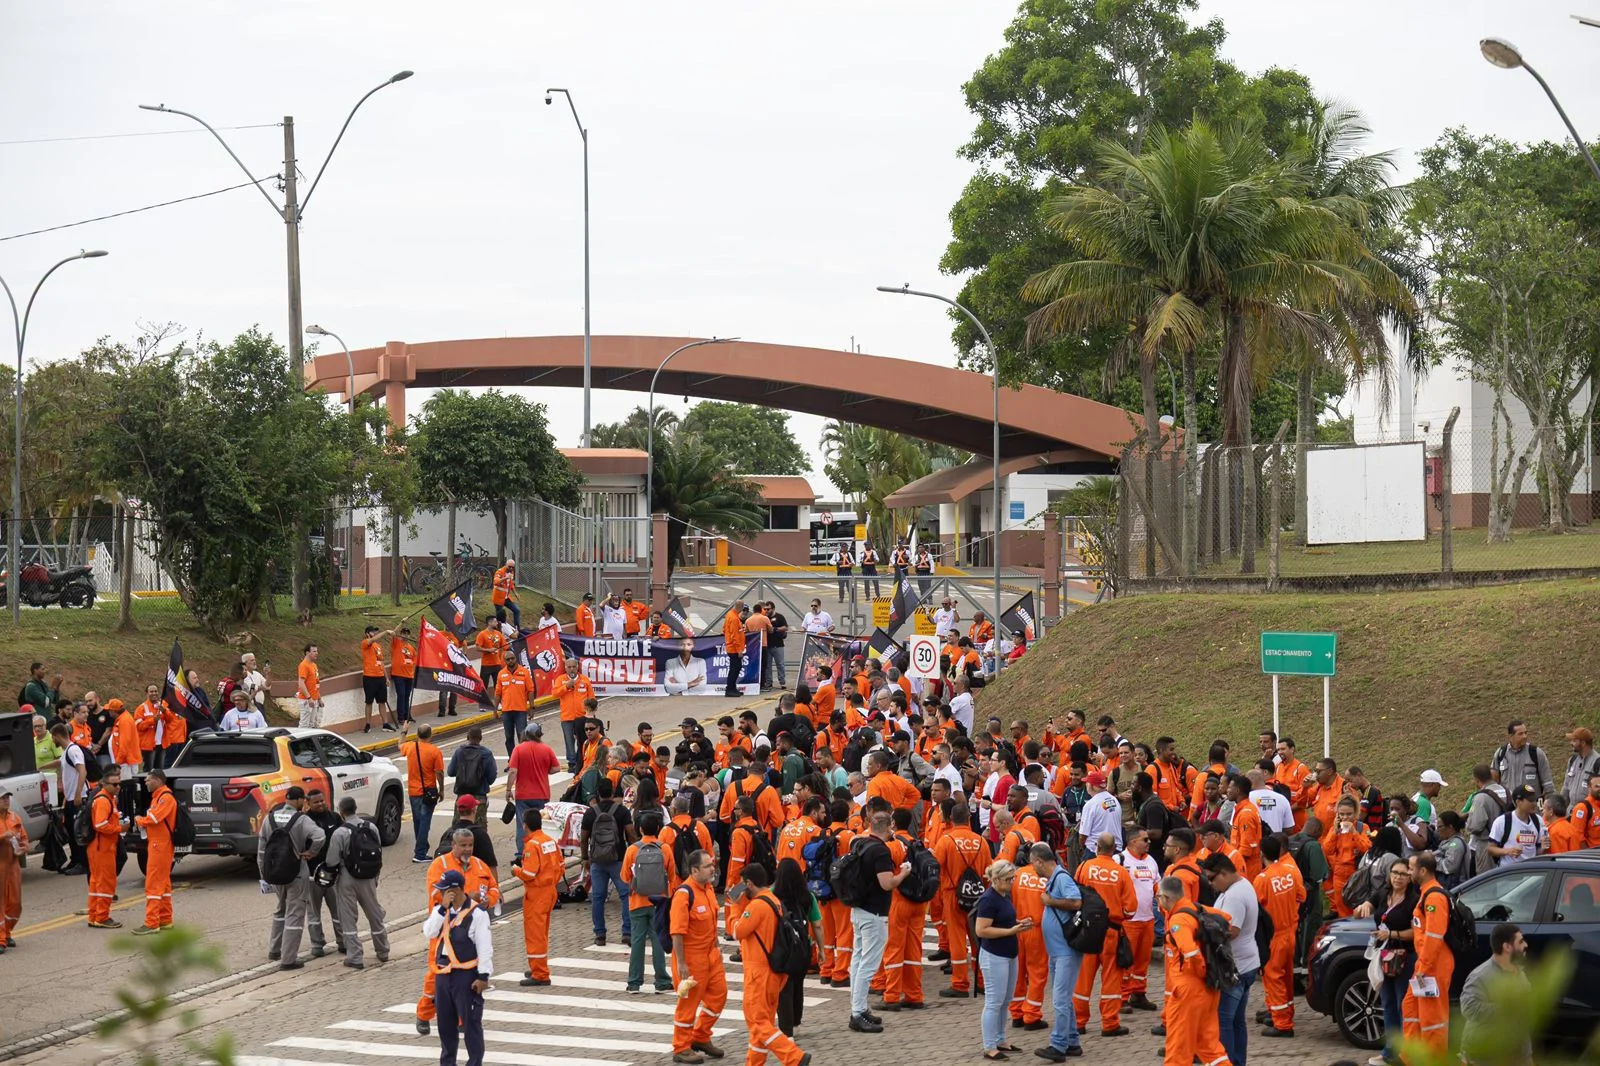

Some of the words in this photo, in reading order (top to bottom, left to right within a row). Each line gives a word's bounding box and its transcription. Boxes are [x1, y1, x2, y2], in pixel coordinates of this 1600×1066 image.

[642, 638, 652, 657] É
[917, 647, 932, 663] 30
[712, 655, 750, 667] NOSS
[581, 657, 655, 683] GREVE
[955, 838, 981, 851] RCS
[1018, 873, 1049, 889] RCS
[1088, 866, 1120, 883] RCS
[961, 881, 986, 896] RCS
[1271, 874, 1294, 893] RCS
